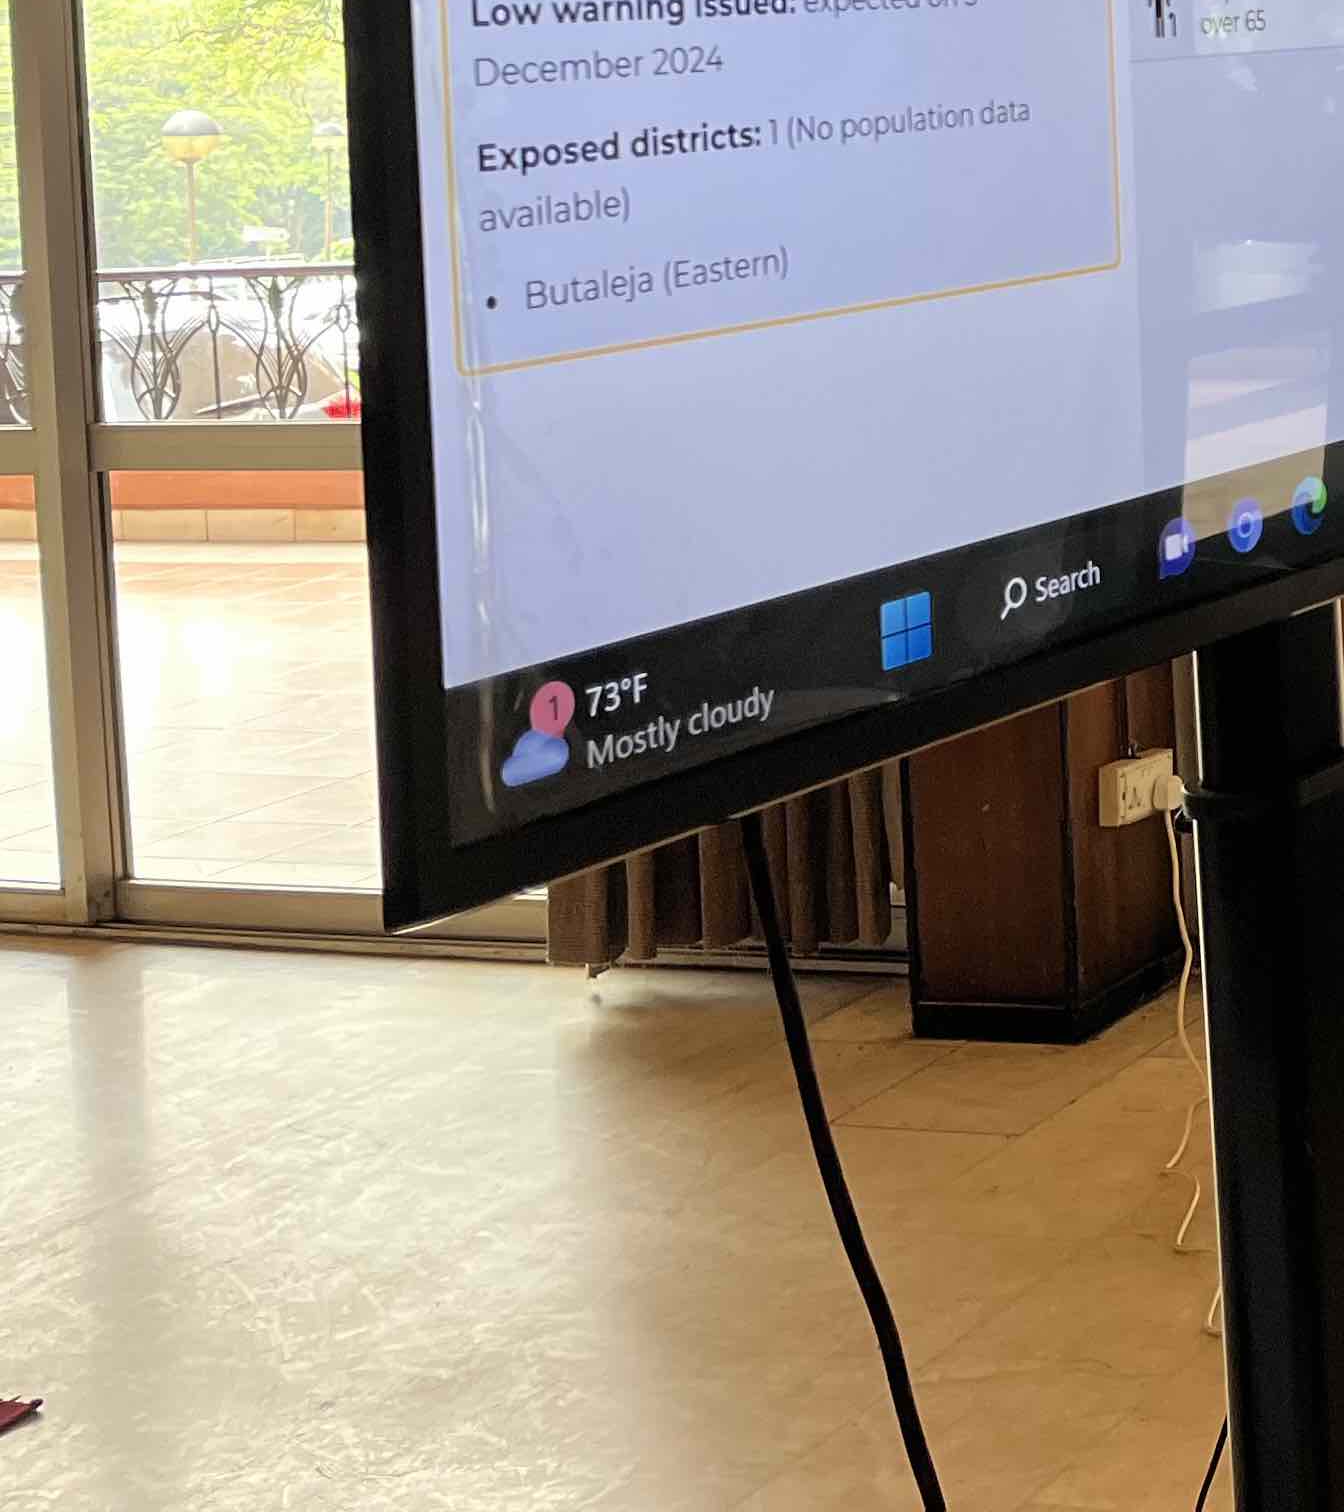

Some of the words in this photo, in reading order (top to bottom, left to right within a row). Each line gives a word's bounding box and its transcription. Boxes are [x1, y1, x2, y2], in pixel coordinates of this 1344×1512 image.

[472, 0, 541, 28] Low
[473, 51, 644, 88] December
[652, 46, 724, 76] 2024
[477, 132, 620, 176] Exposed
[631, 123, 762, 157] districts:
[770, 120, 778, 145] 1
[786, 116, 834, 150] (No
[840, 103, 975, 145] population
[980, 99, 1030, 124] data
[479, 188, 631, 234] available)
[525, 268, 654, 310] Butaleja
[664, 246, 788, 297] (Eastern)
[1035, 562, 1101, 602] Search
[585, 673, 648, 718] 73°F
[587, 716, 681, 769] Mostly
[687, 686, 775, 737] cloudy
